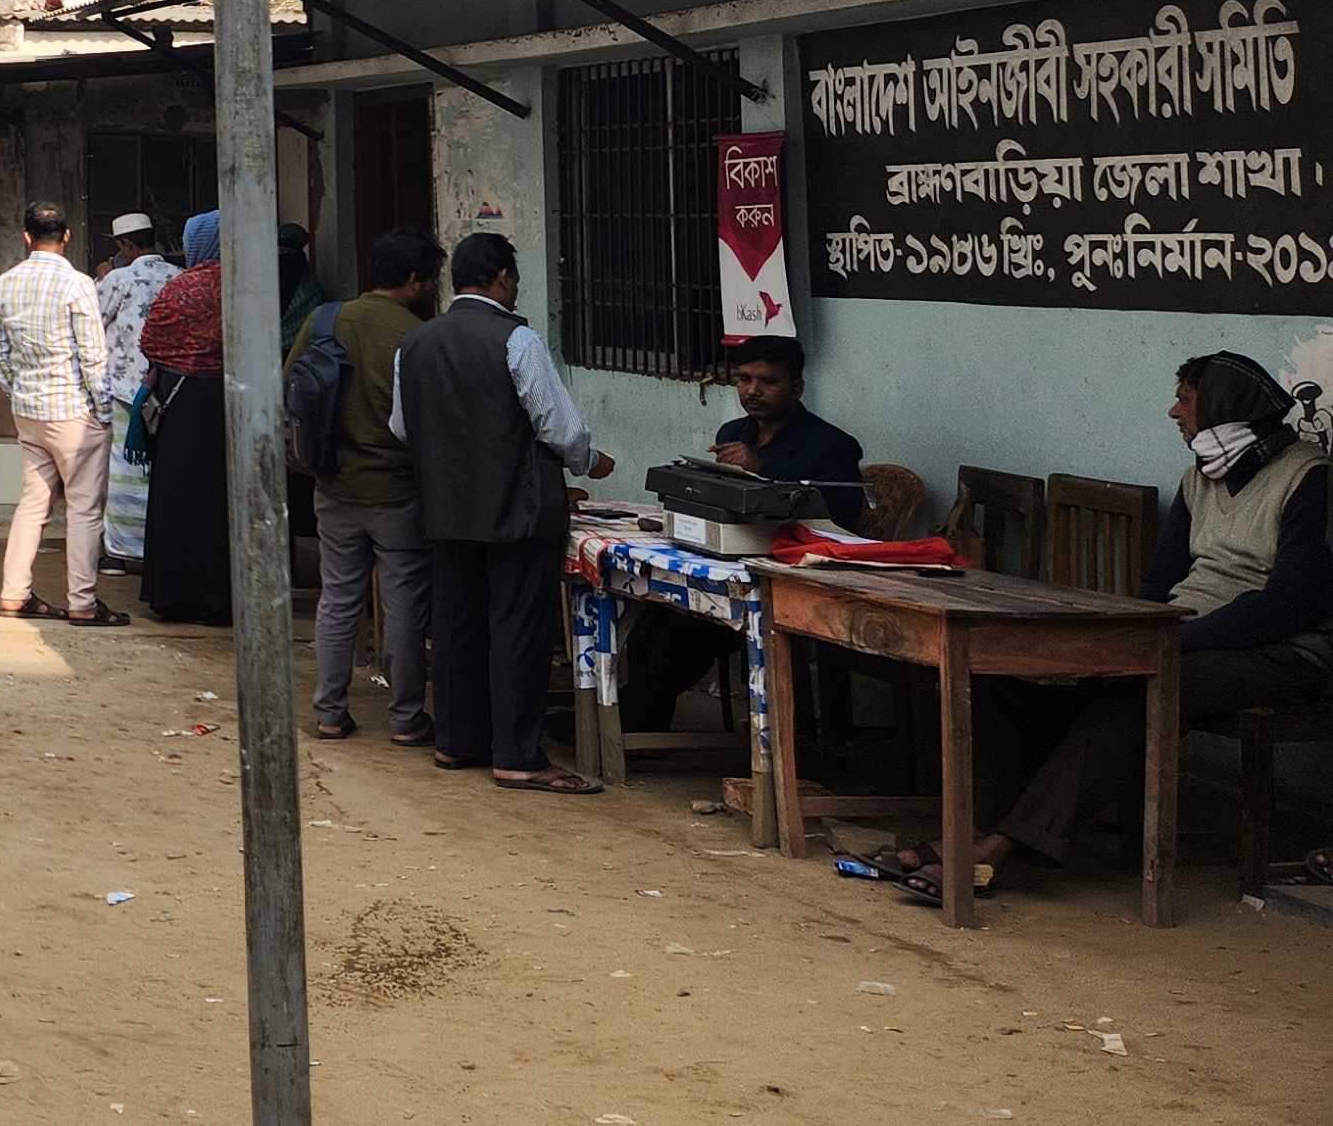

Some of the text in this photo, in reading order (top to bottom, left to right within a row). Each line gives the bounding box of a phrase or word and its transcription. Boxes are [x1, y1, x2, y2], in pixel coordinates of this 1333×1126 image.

[809, 54, 916, 137] বাংলাদেশ
[923, 18, 1070, 131] আইনজীবী
[1073, 5, 1193, 124] সহকারী
[724, 146, 778, 189] বিকাশ
[885, 139, 1084, 216] ব্রাহ্মণবাড়িয়া
[1093, 153, 1191, 206] জেলা
[735, 204, 775, 228] করুন
[737, 304, 762, 322] bKash
